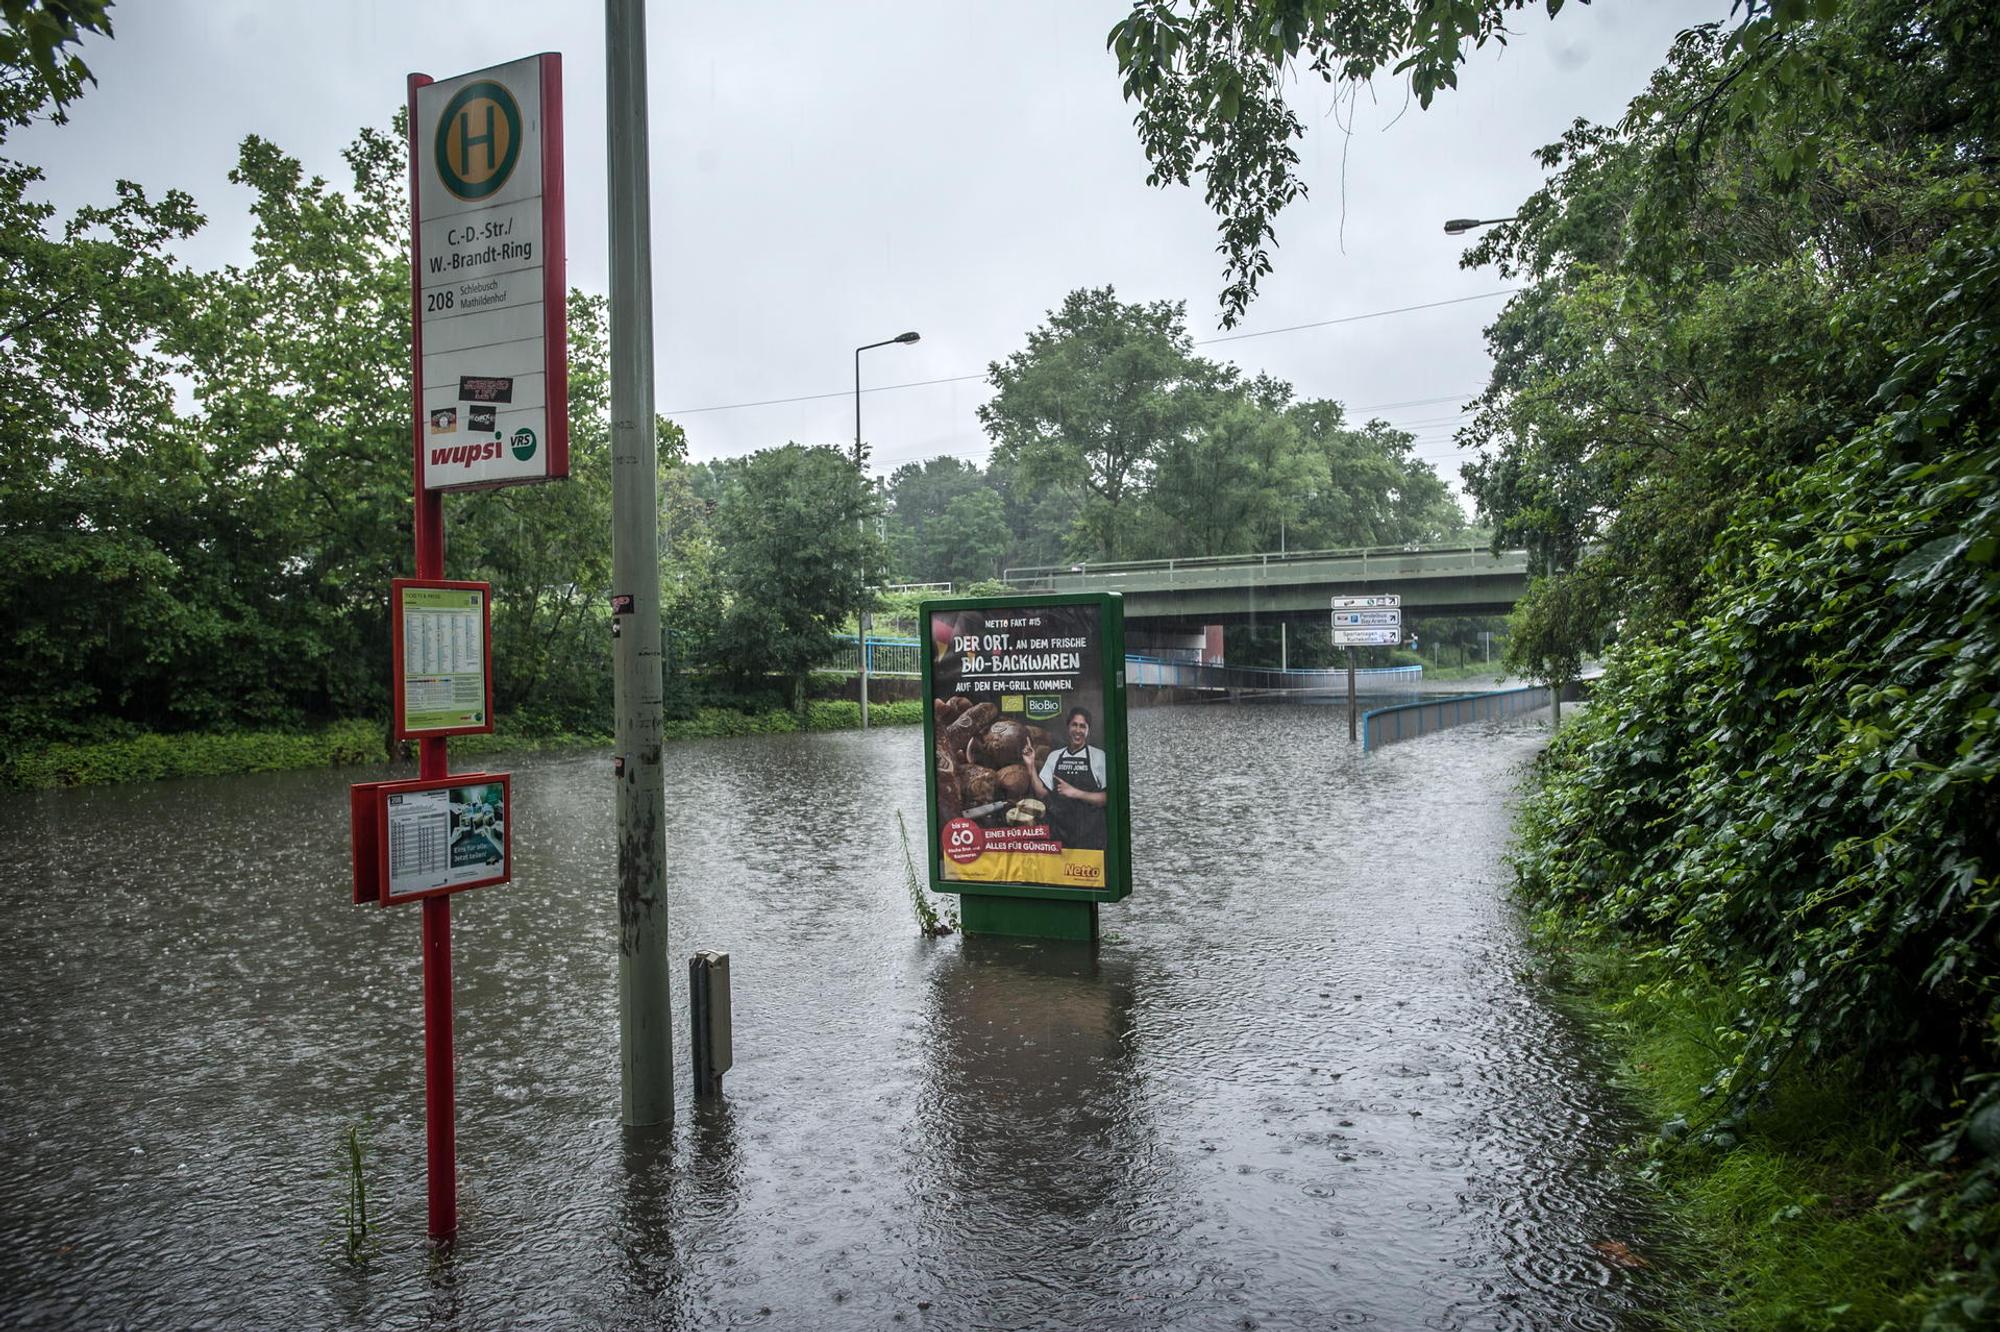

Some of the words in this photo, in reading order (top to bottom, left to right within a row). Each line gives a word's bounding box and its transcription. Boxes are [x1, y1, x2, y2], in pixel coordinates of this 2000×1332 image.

[460, 105, 495, 176] H
[447, 217, 513, 246] C.-D.-Str./
[429, 241, 532, 274] W.-Brandt-Ring
[459, 279, 498, 297] Schlebusch
[427, 291, 454, 313] 208
[460, 292, 507, 310] Mathildenhof
[431, 431, 502, 468] wupsi
[510, 434, 530, 448] VRS
[985, 618, 1009, 628] NETTO
[1010, 617, 1026, 627] FAKT
[953, 635, 980, 653] DER
[1015, 639, 1028, 650] AN
[1030, 638, 1049, 649] DEM
[1051, 636, 1087, 649] FRISCHE
[961, 652, 1080, 673] BIO-BACKWAREN
[955, 681, 971, 692] AUF
[974, 681, 990, 691] DEN
[992, 680, 1031, 691] EM-GRILL
[1033, 679, 1074, 691] KOMMEN.
[951, 822, 961, 830] bis
[984, 830, 1006, 839] EINER
[1006, 828, 1021, 838] FÜR
[1022, 827, 1047, 837] ALLES.
[951, 830, 974, 846] 60
[985, 842, 1007, 851] ALLES
[1008, 841, 1022, 850] FÜR
[1023, 841, 1059, 852] GÜNSTIG.
[1064, 863, 1101, 878] Netto
